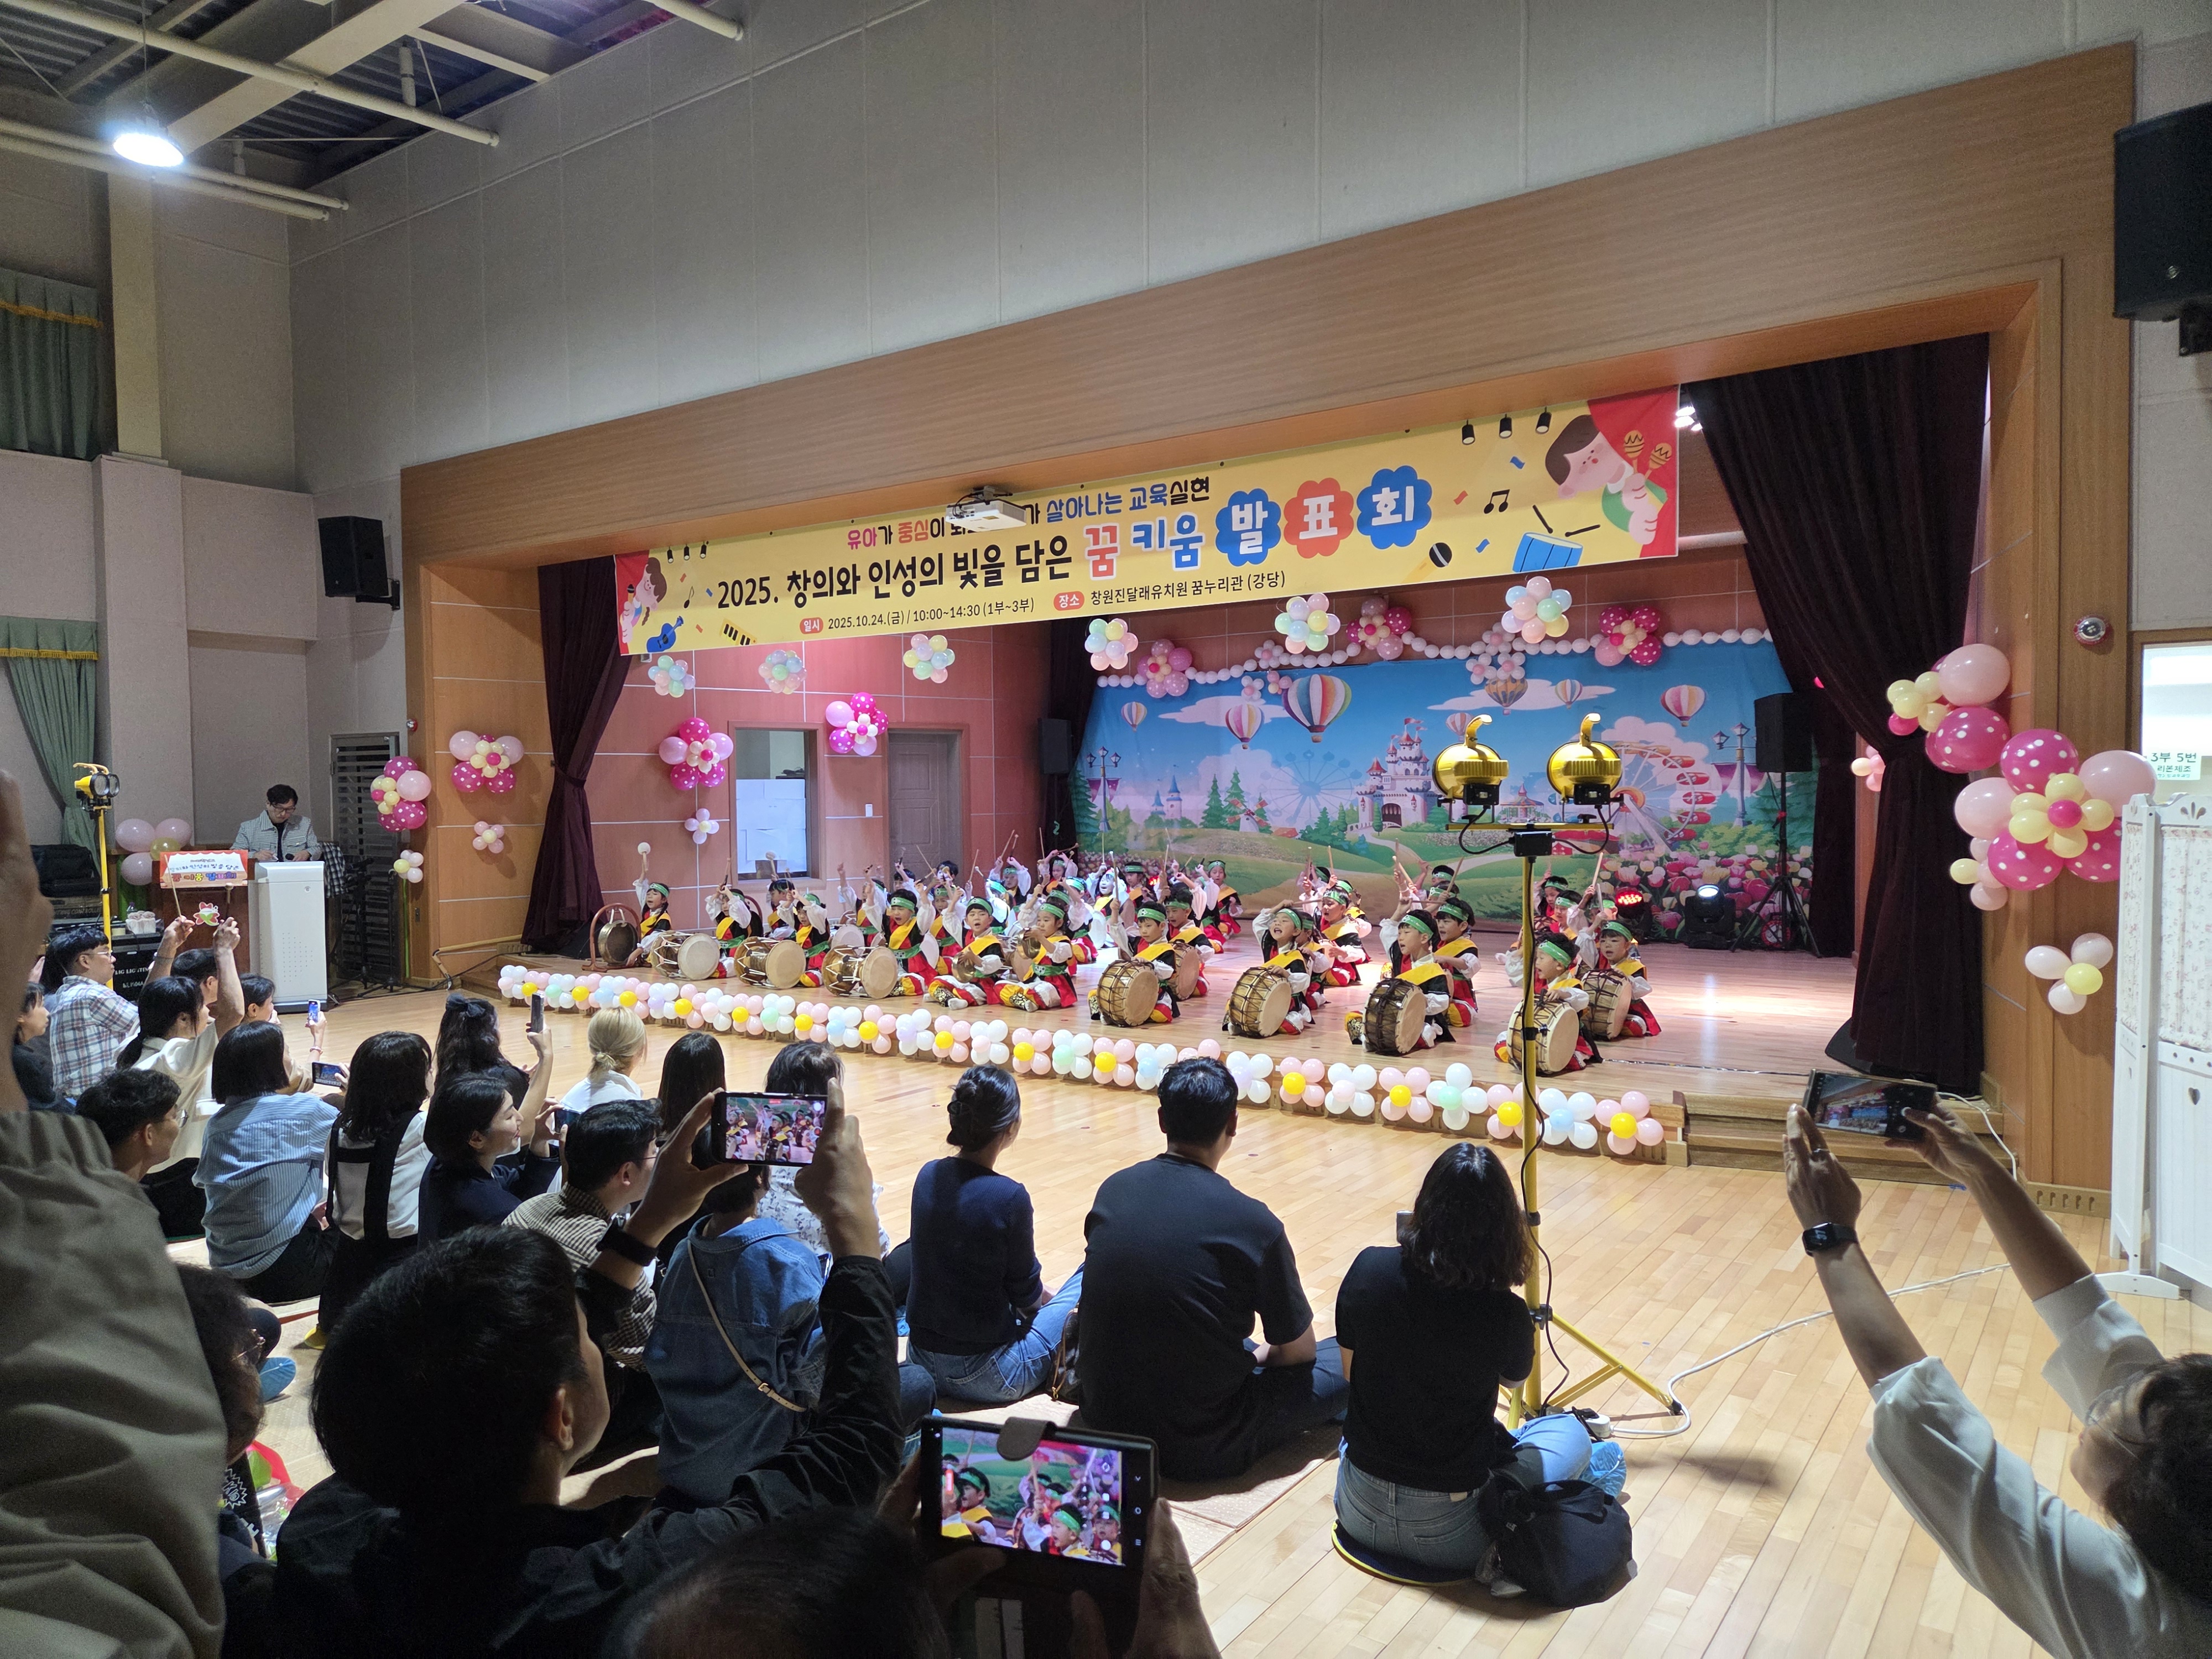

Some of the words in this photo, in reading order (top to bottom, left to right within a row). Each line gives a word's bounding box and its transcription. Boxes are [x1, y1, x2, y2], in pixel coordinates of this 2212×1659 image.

[1047, 492, 1123, 523] 살아나는
[847, 525, 893, 550] 유아가
[898, 518, 945, 544] 중심이
[718, 576, 779, 609] 2025.
[786, 565, 861, 608] 창의와
[868, 552, 943, 599] 인성의
[953, 544, 1005, 590] 빛을
[1015, 535, 1072, 583] 담은
[1084, 524, 1119, 578] 꿈
[1132, 513, 1204, 569] 키움
[1058, 593, 1079, 608] 장소
[1091, 581, 1188, 606] 창원진달래유치원
[1191, 575, 1244, 596] 꿈누리관
[1247, 570, 1286, 592] (강당)
[804, 618, 820, 632] 일시
[828, 610, 905, 630] 2025.10.24.(금)
[913, 604, 980, 622] 10:00~14:30
[983, 597, 1034, 617] (1부~3부)
[2151, 752, 2171, 763] 3부
[2177, 752, 2197, 763] 5번
